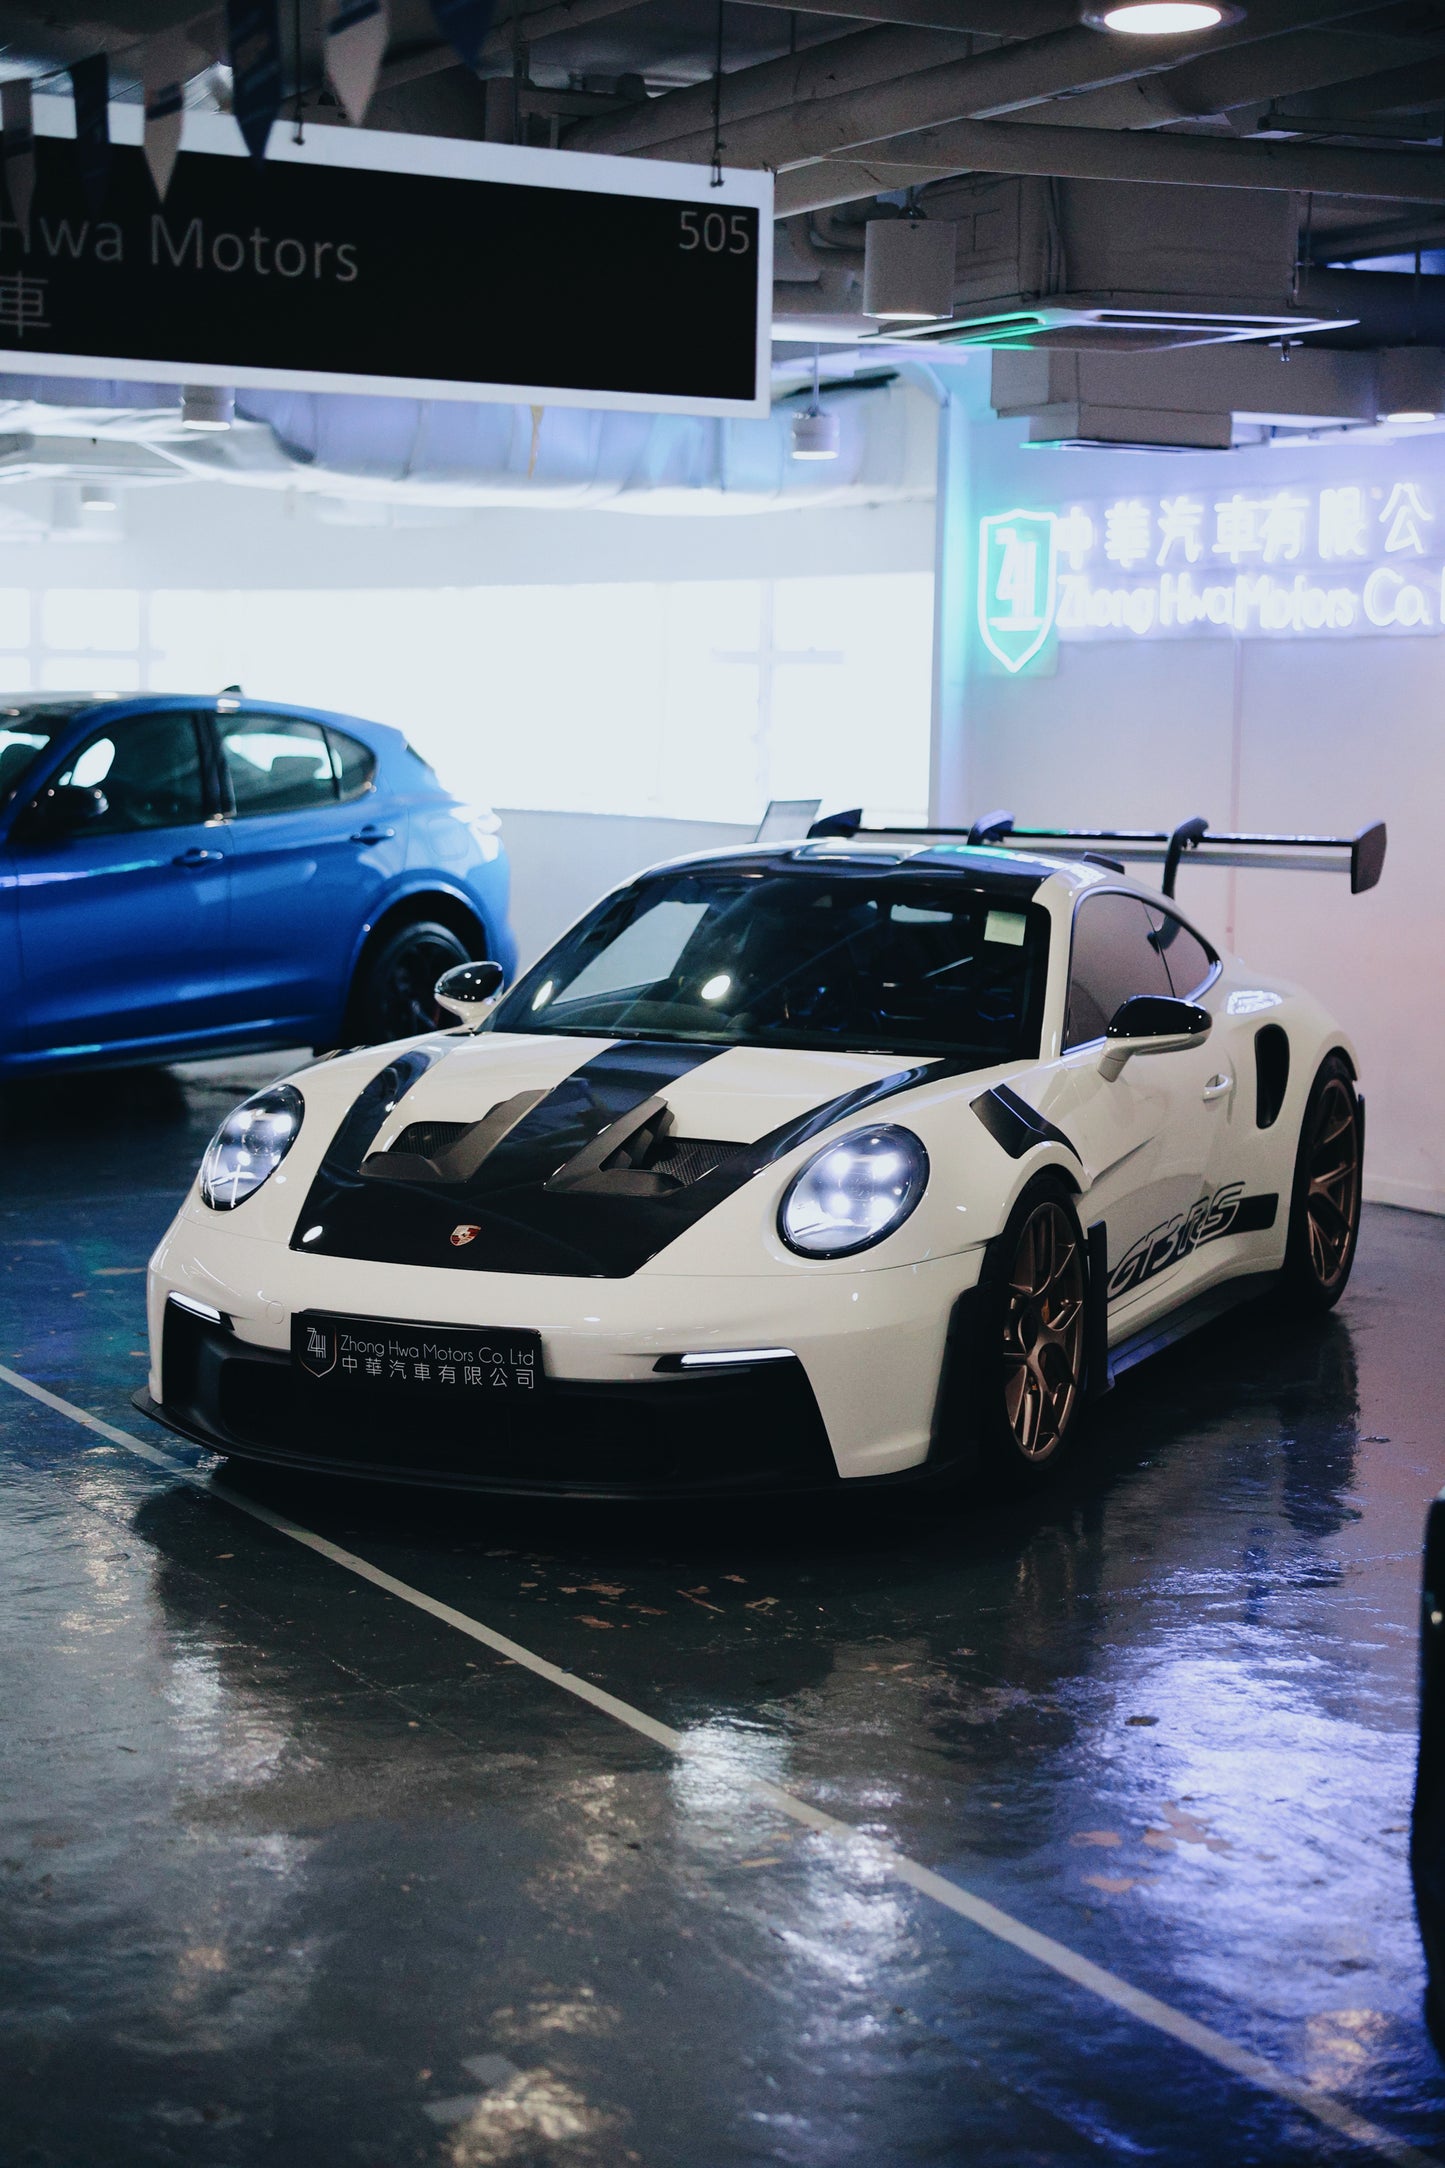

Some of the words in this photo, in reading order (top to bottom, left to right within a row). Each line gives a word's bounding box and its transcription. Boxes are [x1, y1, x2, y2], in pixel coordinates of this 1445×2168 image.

[150, 213, 359, 283] Motors
[678, 210, 749, 254] 505
[340, 1334, 385, 1357] Zhong
[388, 1339, 419, 1358] Hwa
[423, 1343, 474, 1362] Motors
[478, 1346, 505, 1365] Co.
[510, 1348, 534, 1366] Ltd
[341, 1354, 534, 1389] 中華汽車有限公司
